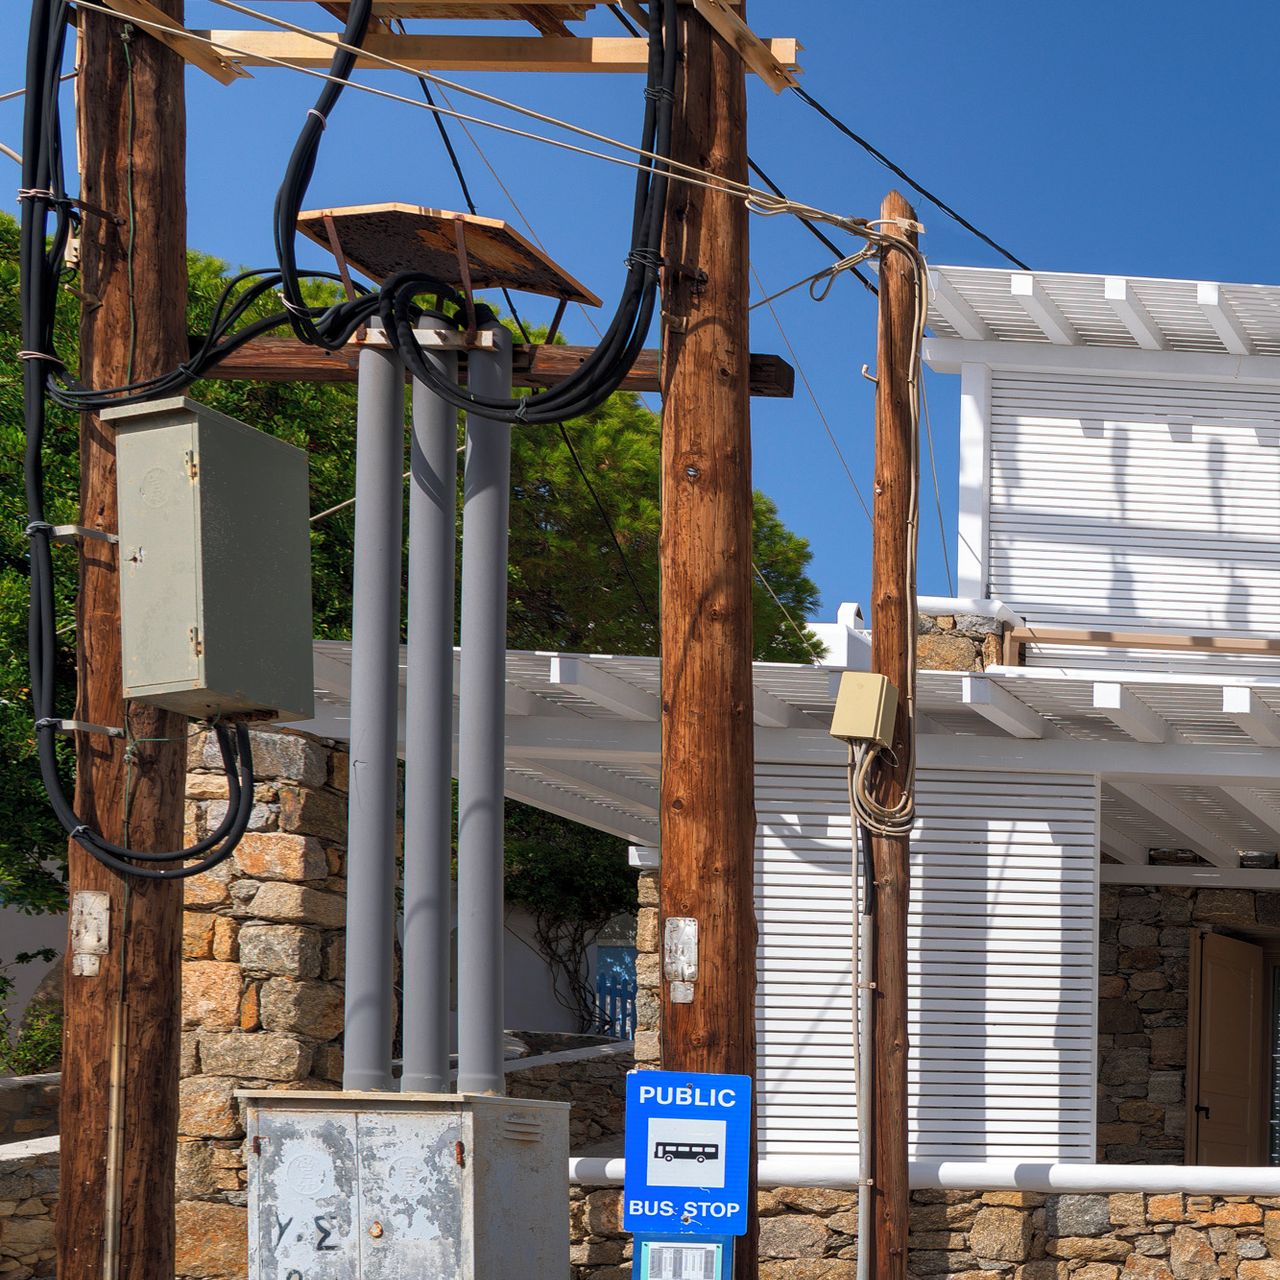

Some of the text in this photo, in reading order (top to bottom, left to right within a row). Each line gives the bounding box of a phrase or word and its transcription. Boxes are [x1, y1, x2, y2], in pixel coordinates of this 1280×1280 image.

[639, 1085, 736, 1108] PUBLIC
[629, 1200, 740, 1218] BUS STOP
